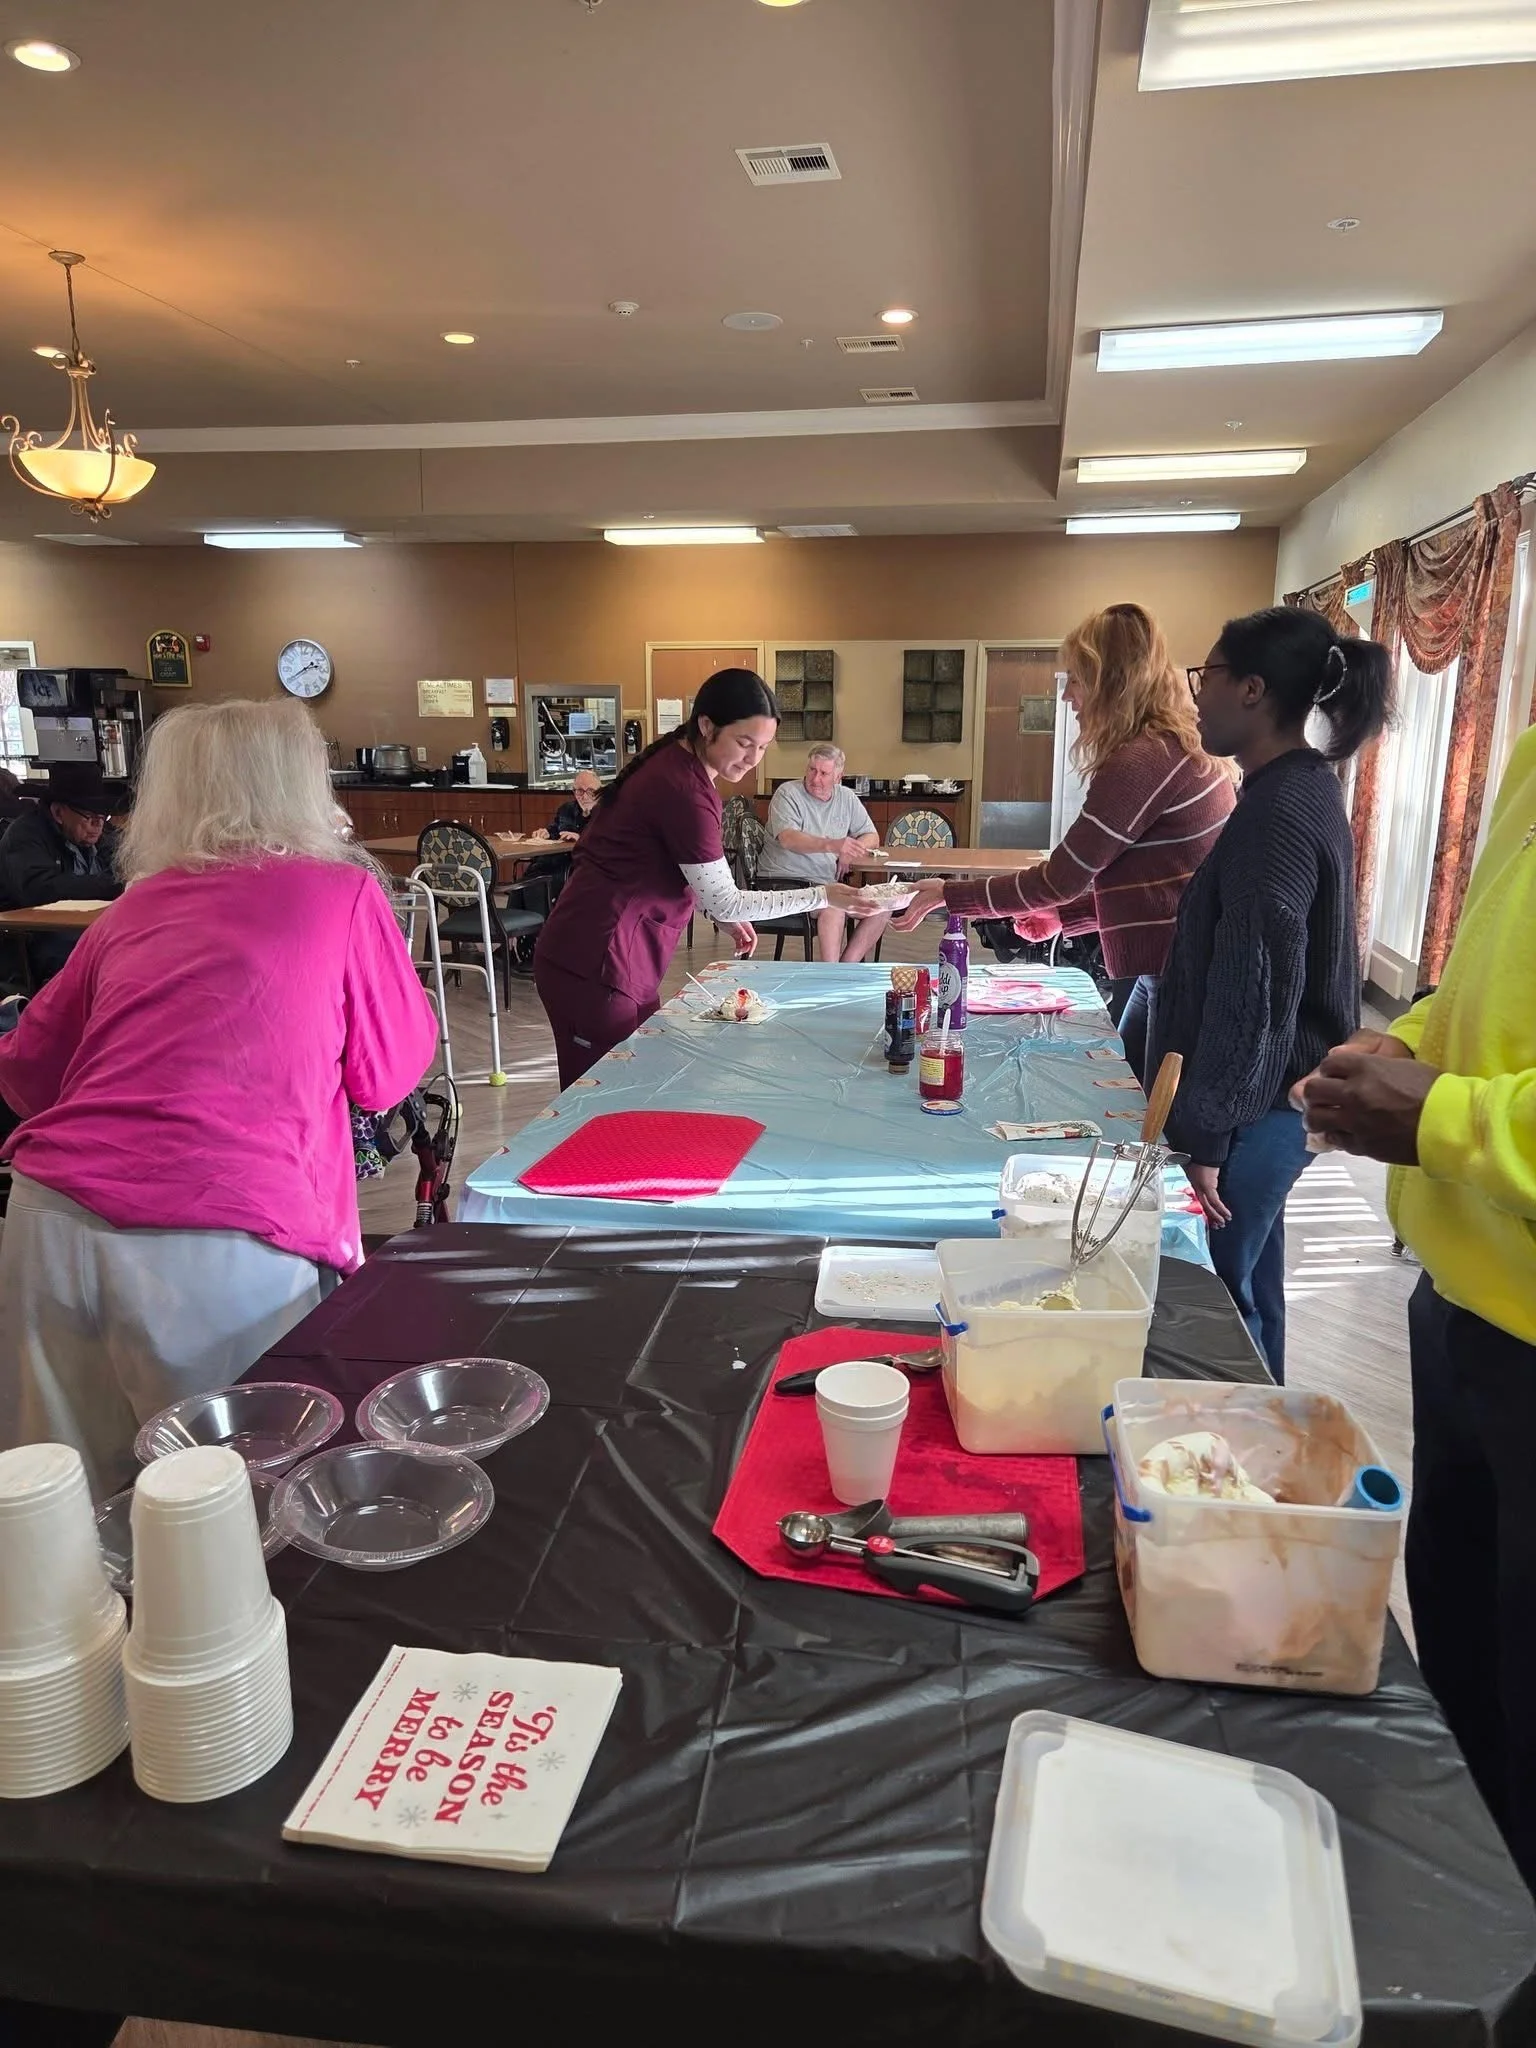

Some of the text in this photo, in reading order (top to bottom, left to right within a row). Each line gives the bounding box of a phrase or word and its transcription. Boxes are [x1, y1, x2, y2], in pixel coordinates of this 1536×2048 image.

[354, 1687, 441, 1811] MERRY
[406, 1715, 464, 1782] to be
[434, 1690, 515, 1825] SEASON
[480, 1762, 528, 1806] the
